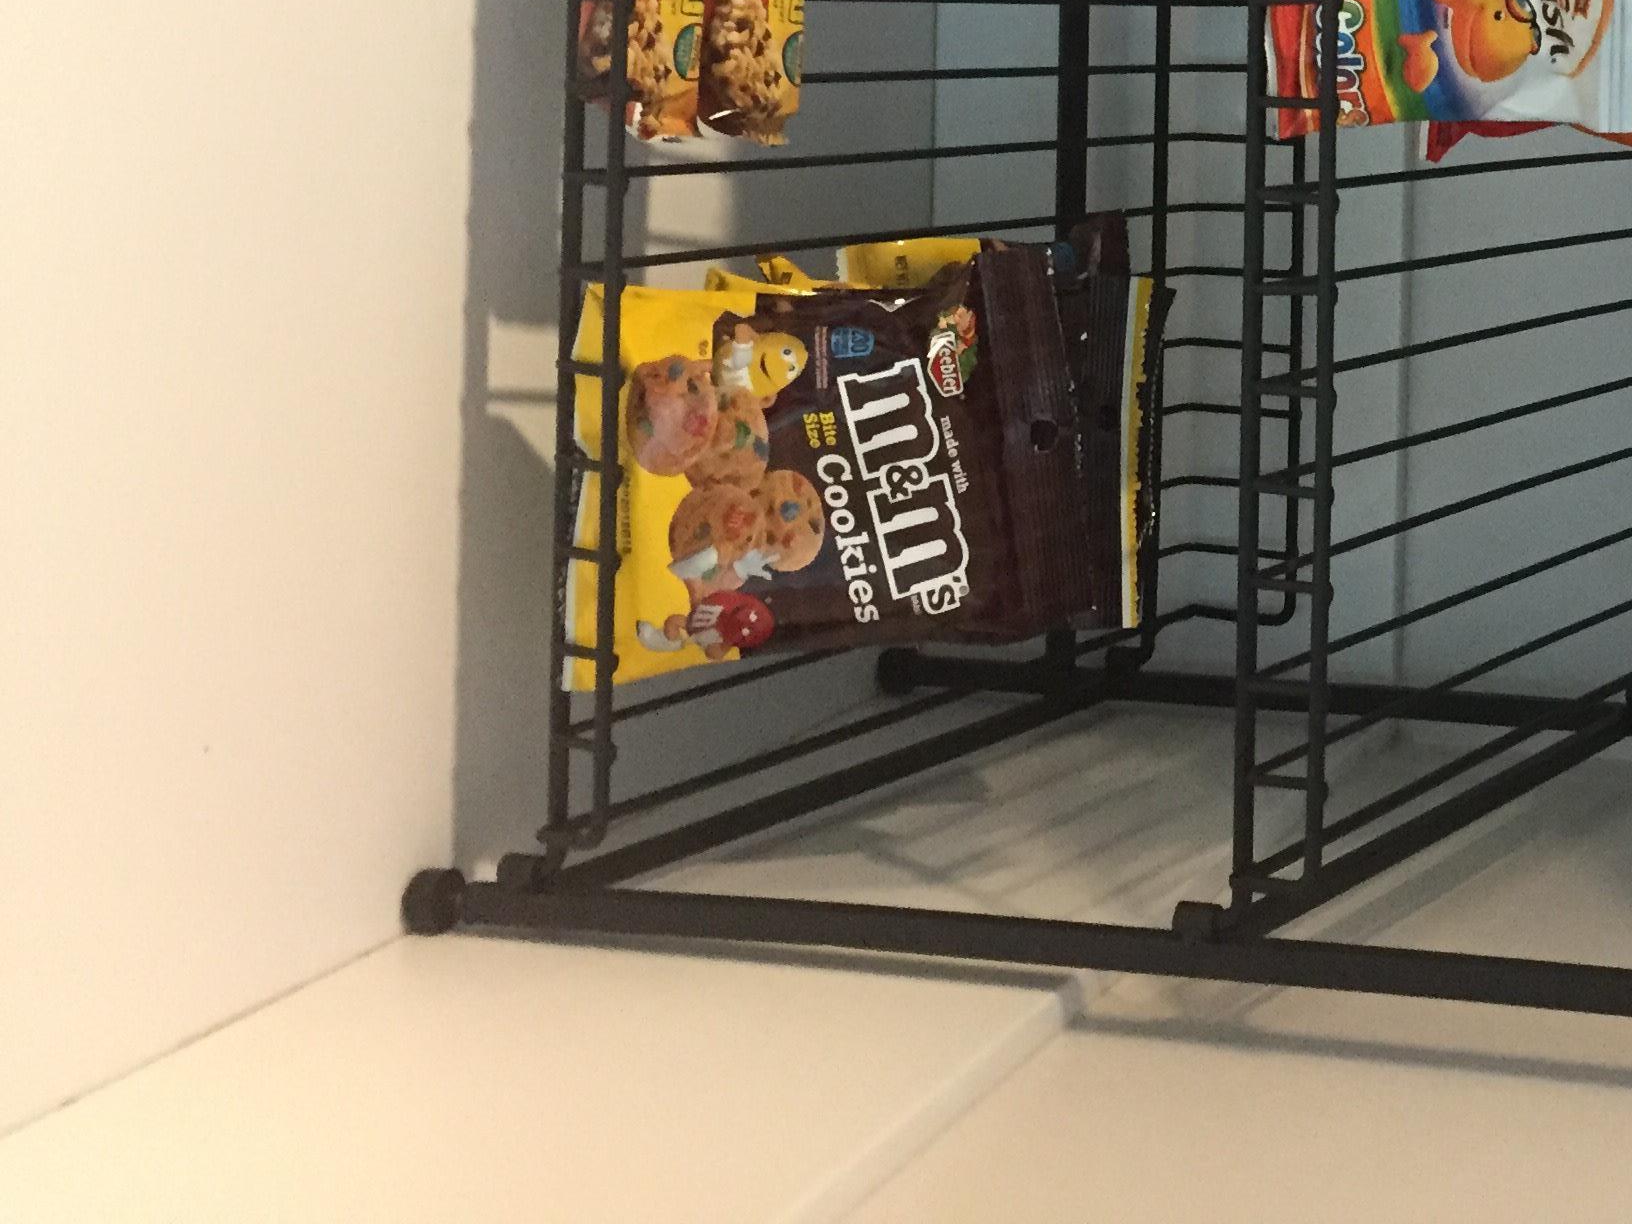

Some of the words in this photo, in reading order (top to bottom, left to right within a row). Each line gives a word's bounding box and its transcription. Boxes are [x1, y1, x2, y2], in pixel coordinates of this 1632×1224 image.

[934, 333, 959, 394] Keebler
[801, 412, 822, 449] Size
[818, 411, 838, 447] Bite
[940, 416, 959, 458] made
[950, 459, 970, 494] with
[815, 453, 881, 624] Cookies
